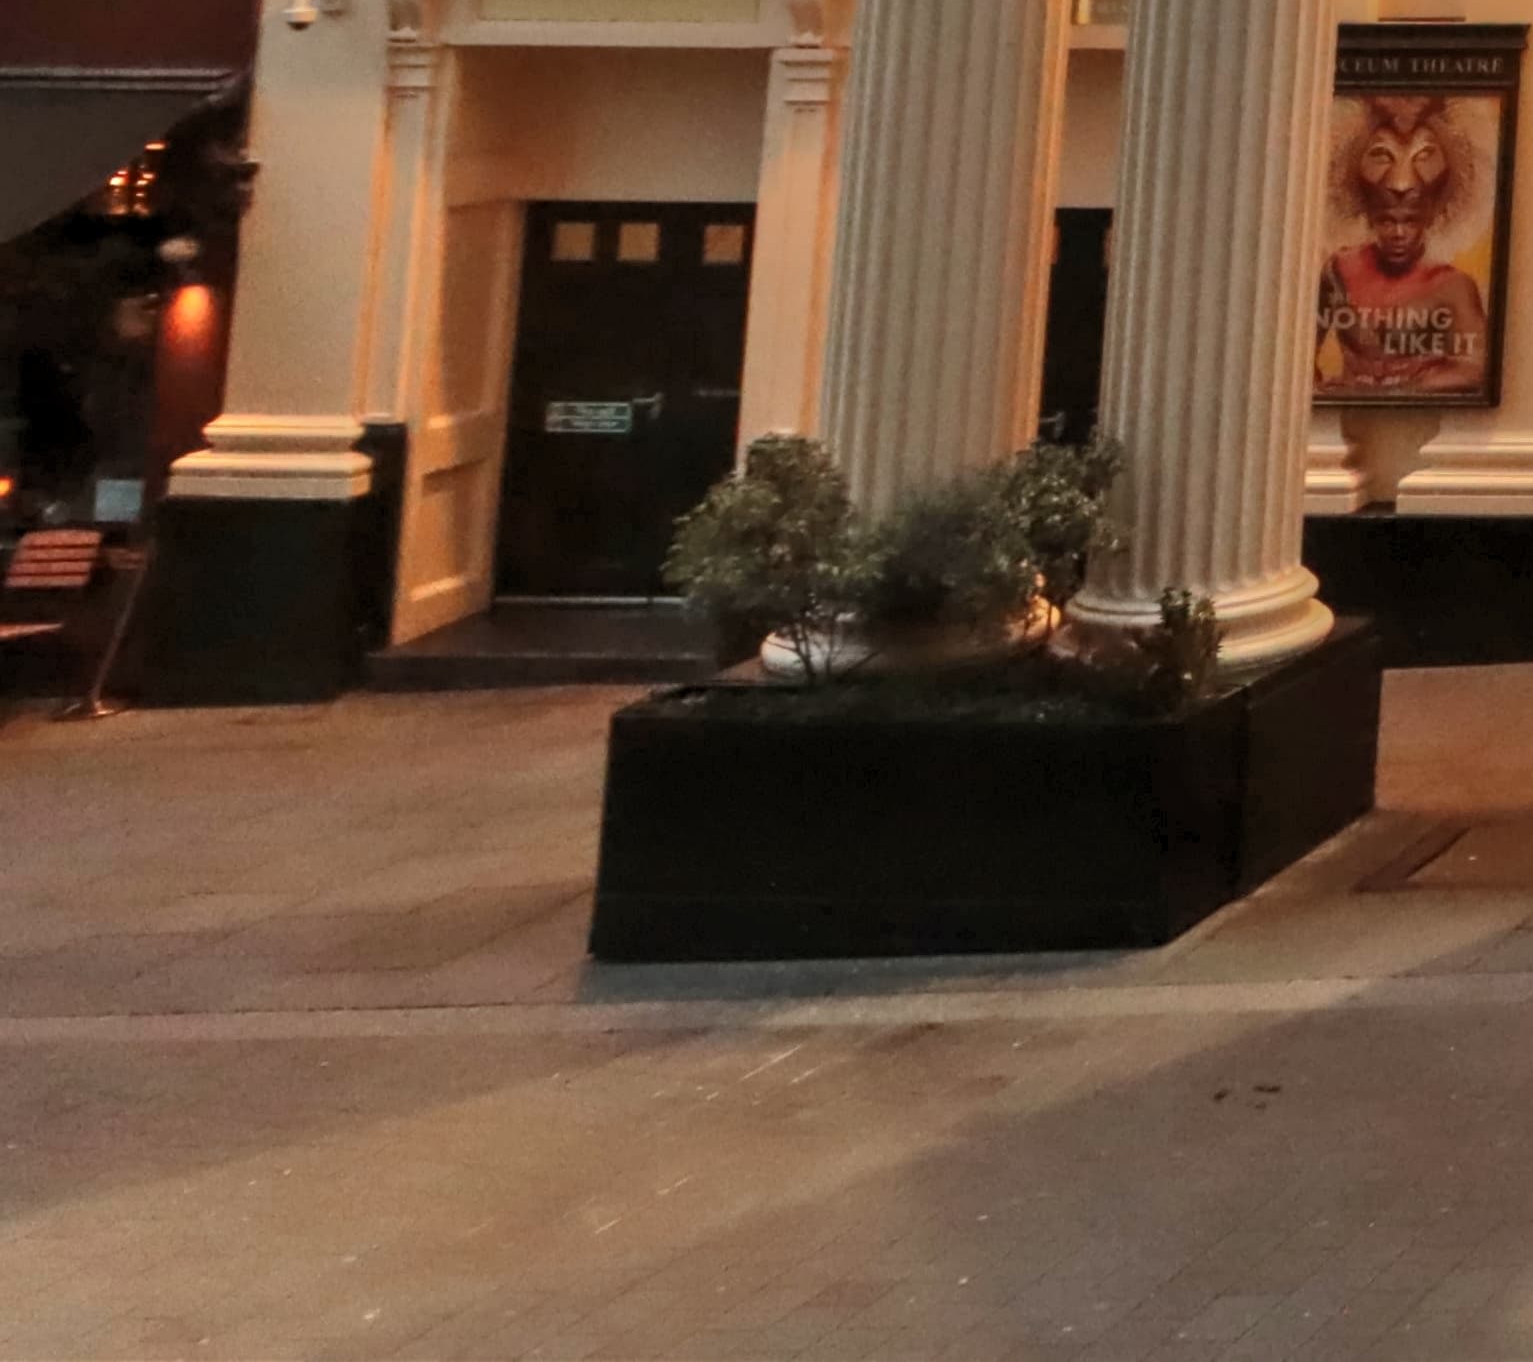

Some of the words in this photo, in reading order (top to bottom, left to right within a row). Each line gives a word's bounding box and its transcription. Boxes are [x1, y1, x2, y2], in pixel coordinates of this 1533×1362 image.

[1341, 57, 1399, 74] CEUM
[1411, 57, 1503, 73] THEATRE
[1317, 306, 1453, 329] NOTHING
[1384, 332, 1444, 355] LIKE
[1454, 332, 1477, 355] IT
